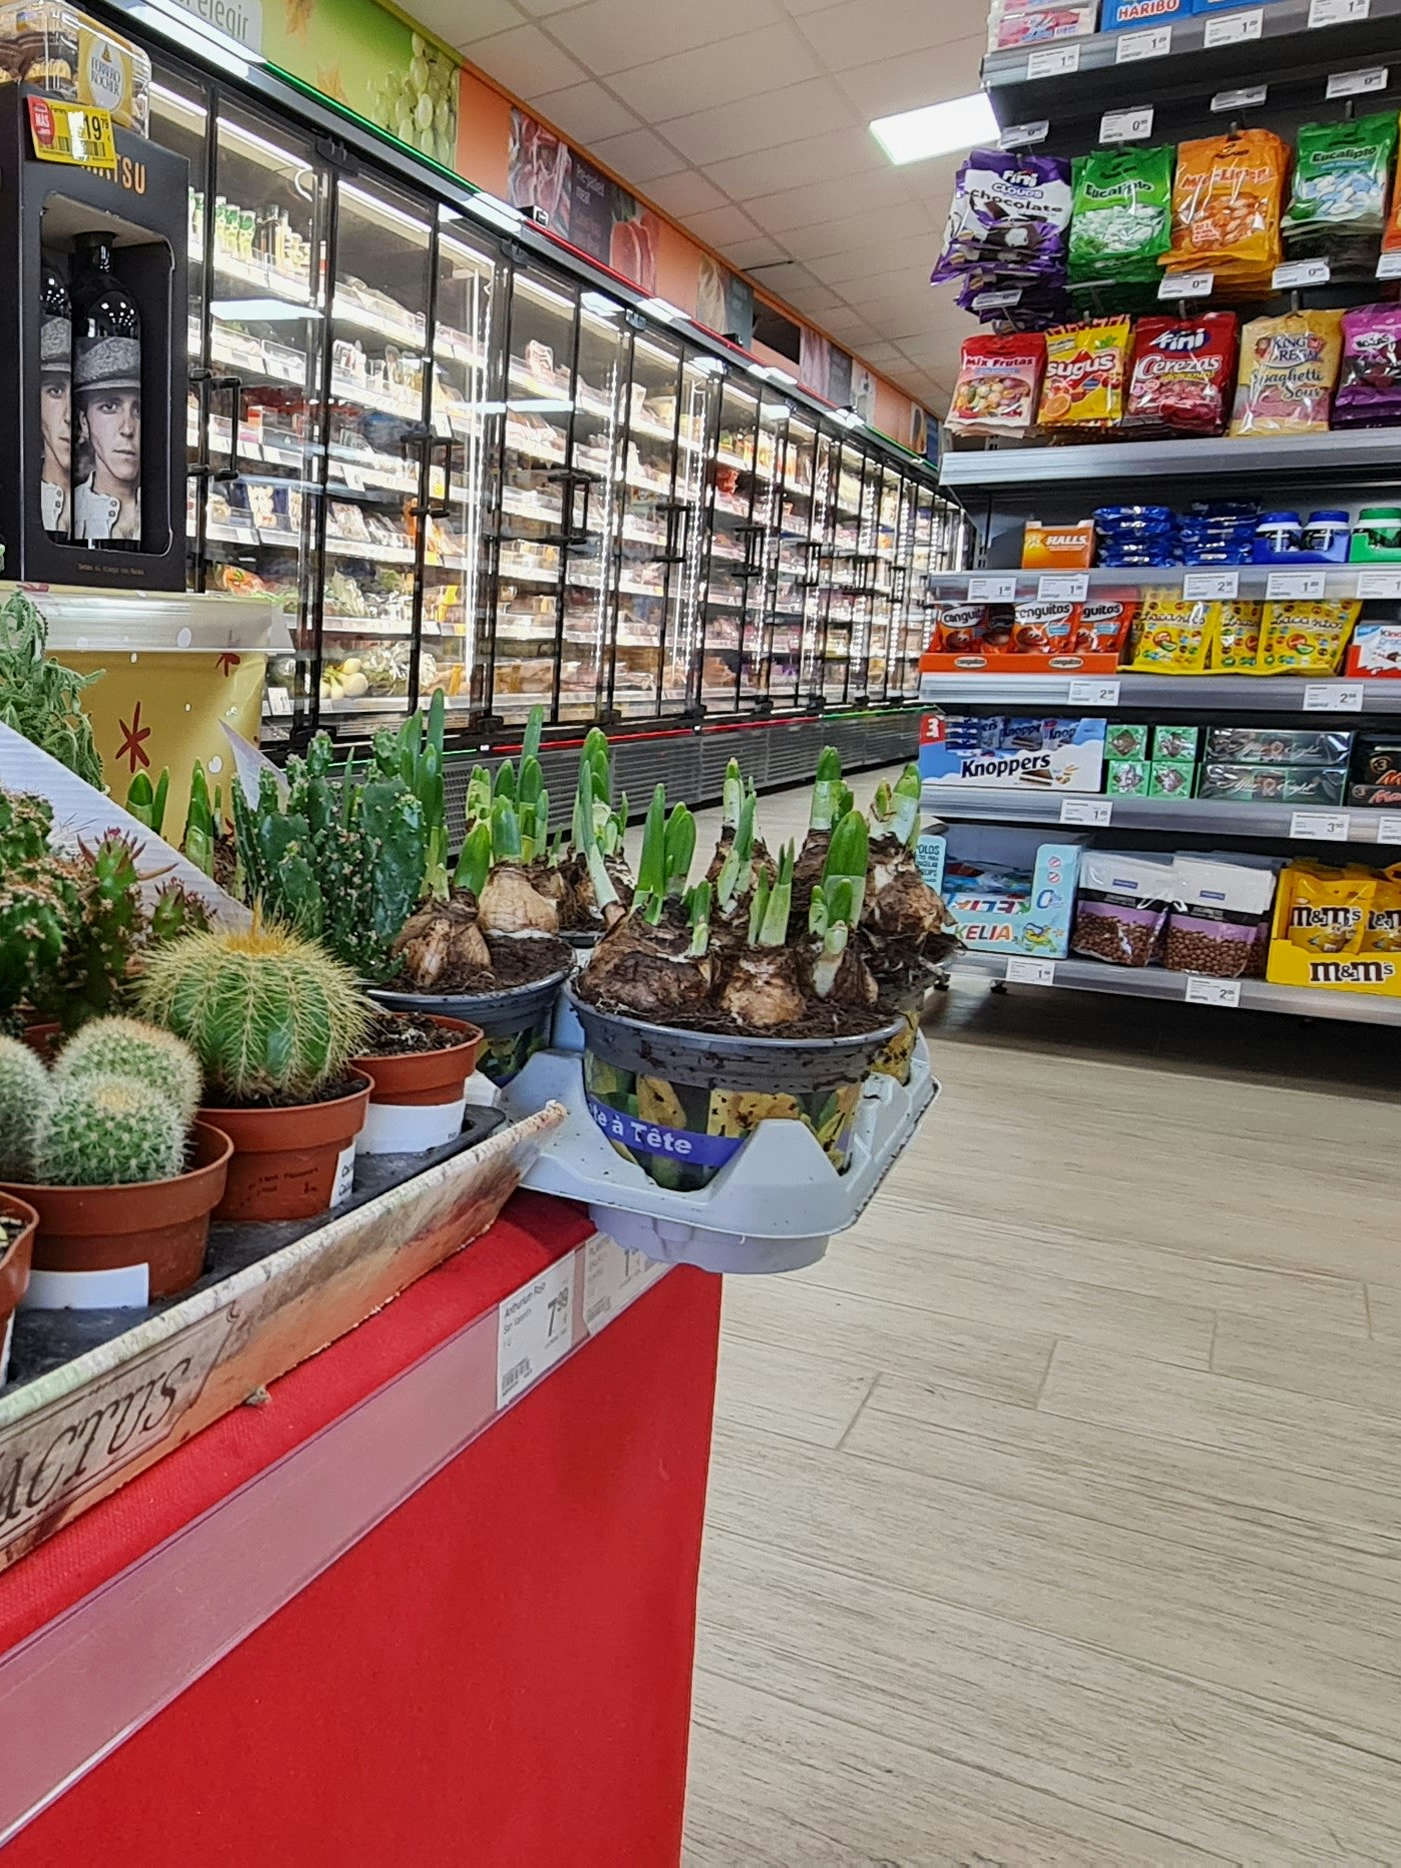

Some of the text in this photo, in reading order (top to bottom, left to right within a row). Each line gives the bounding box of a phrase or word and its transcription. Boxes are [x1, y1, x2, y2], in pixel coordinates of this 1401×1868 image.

[1118, 0, 1180, 20] HARIBO
[972, 188, 1064, 213] chocolate
[966, 354, 1034, 368] Mix Frutas
[1136, 355, 1222, 380] Cerezas
[1046, 535, 1088, 546] HALLS
[961, 754, 1051, 779] Knoppers
[955, 924, 1015, 941] KELIA
[612, 1115, 623, 1136] à
[630, 1121, 693, 1155] Tête
